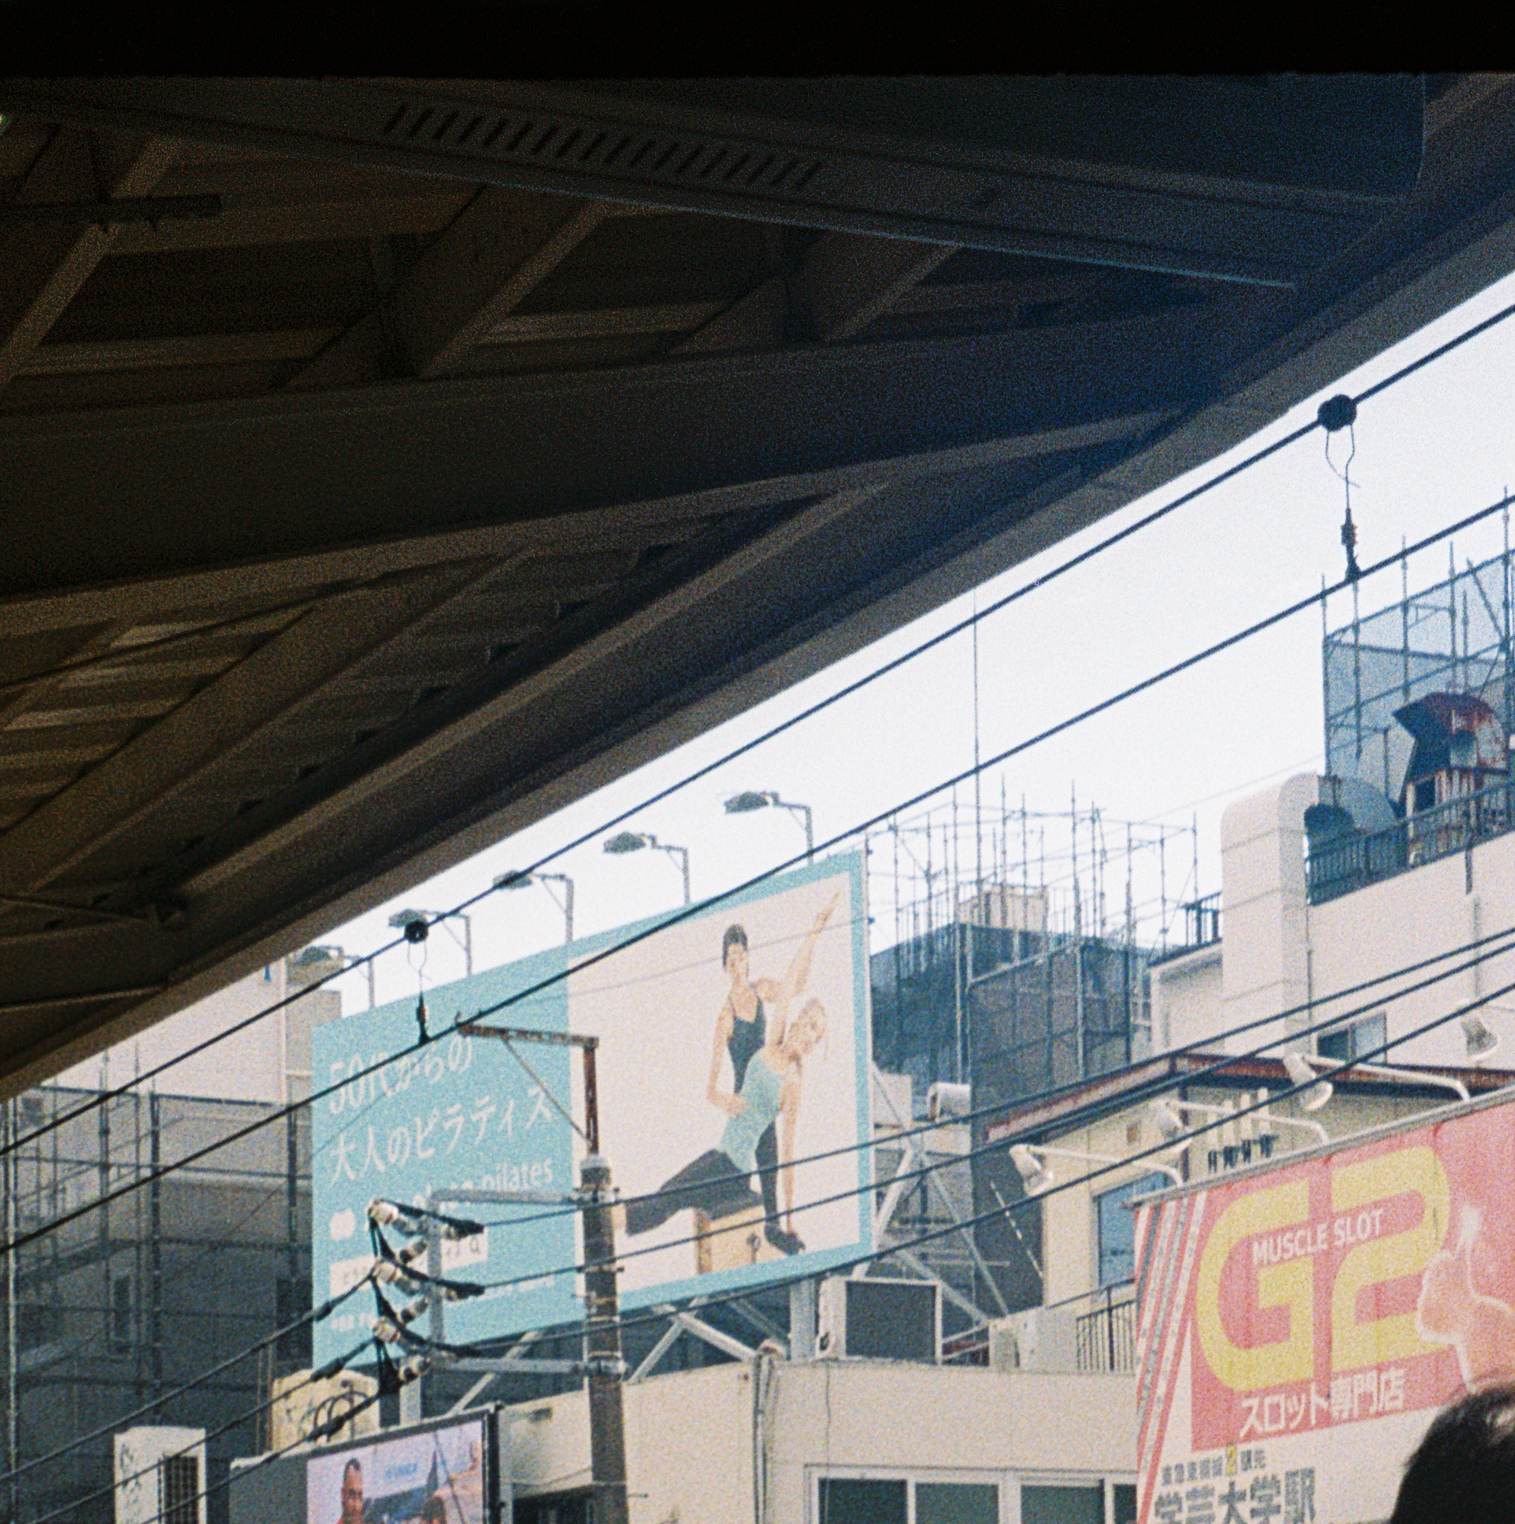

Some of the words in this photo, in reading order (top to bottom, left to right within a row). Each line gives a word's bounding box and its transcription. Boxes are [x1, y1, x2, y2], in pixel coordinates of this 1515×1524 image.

[330, 1087, 553, 1189] 大人のピラティス
[1196, 1146, 1451, 1392] G2
[1252, 1222, 1327, 1265] MUSCLE
[1335, 1208, 1384, 1247] SLOT
[1240, 1369, 1404, 1438] スロット専門店
